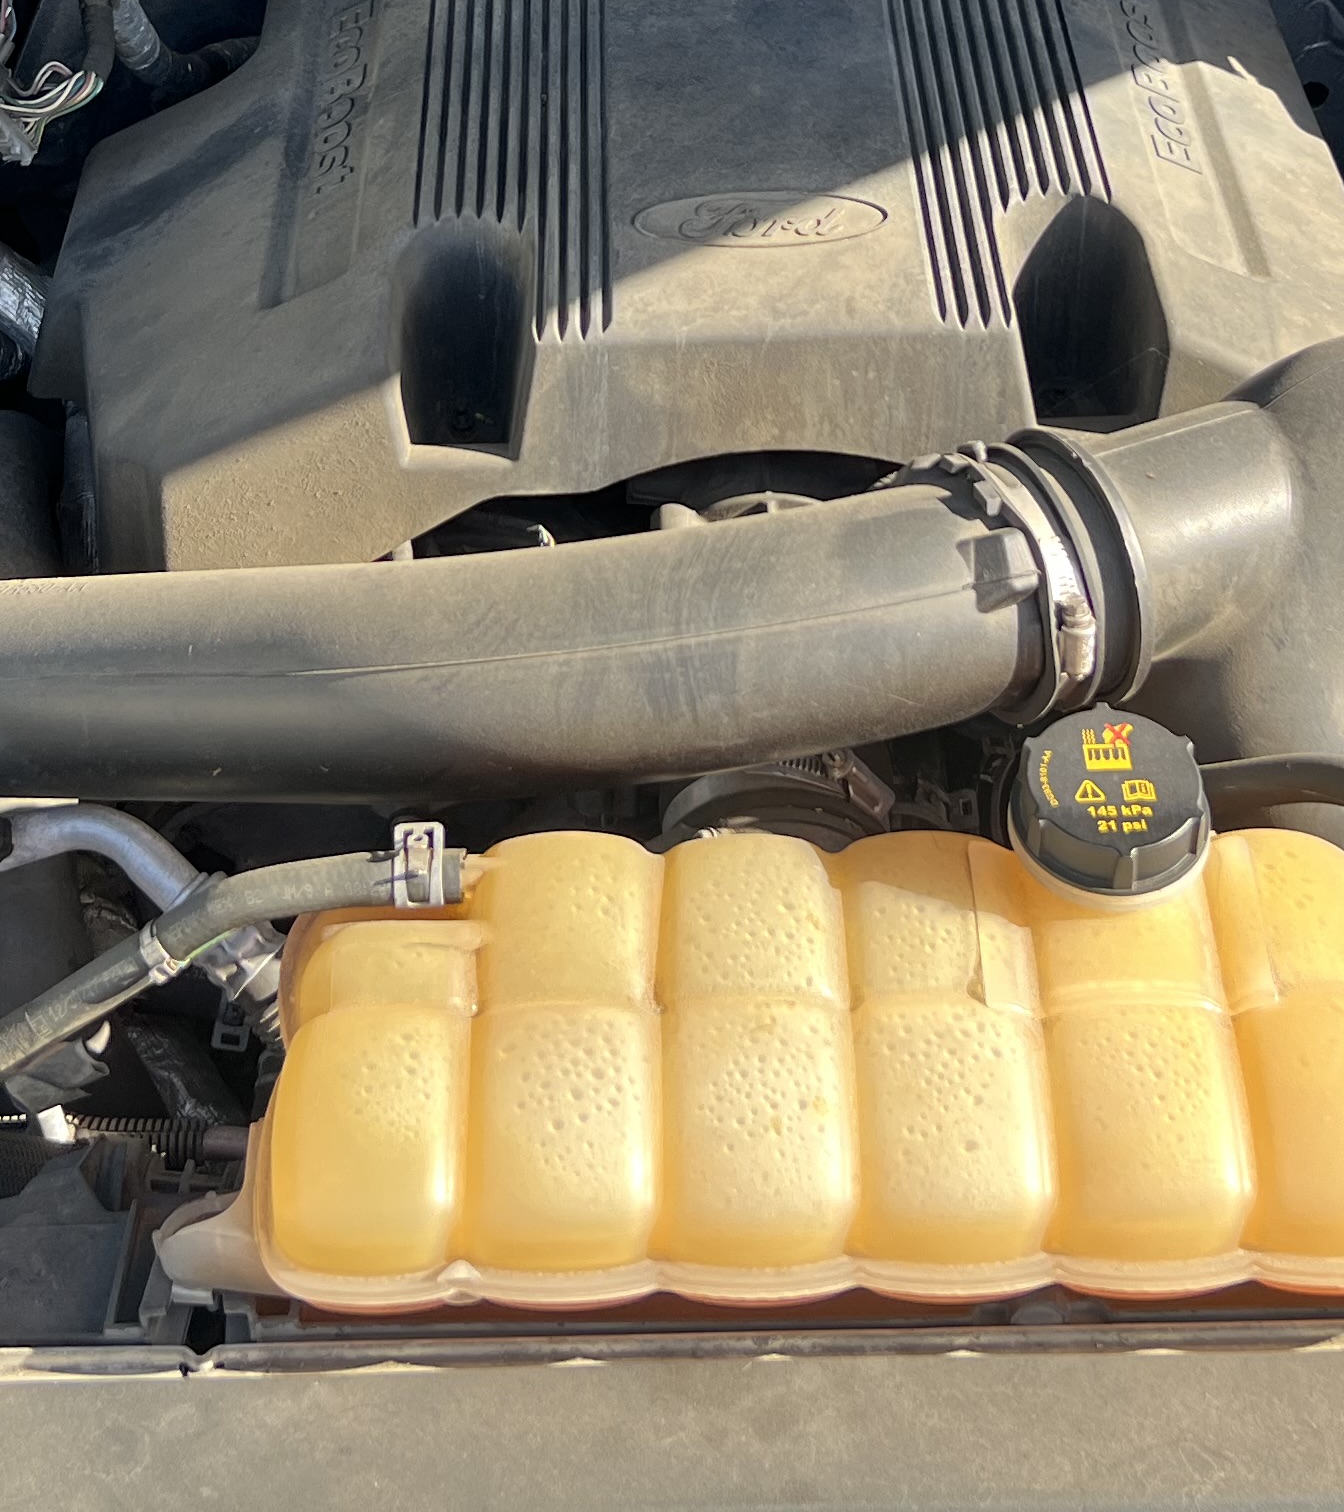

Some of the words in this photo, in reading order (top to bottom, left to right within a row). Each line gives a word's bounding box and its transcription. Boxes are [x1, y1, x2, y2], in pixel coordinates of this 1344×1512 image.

[674, 195, 848, 239] Ford
[1087, 805, 1118, 818] 145
[1121, 804, 1153, 818] kPa
[1097, 820, 1118, 832] 21
[1122, 819, 1149, 834] psi
[244, 888, 263, 905] B2
